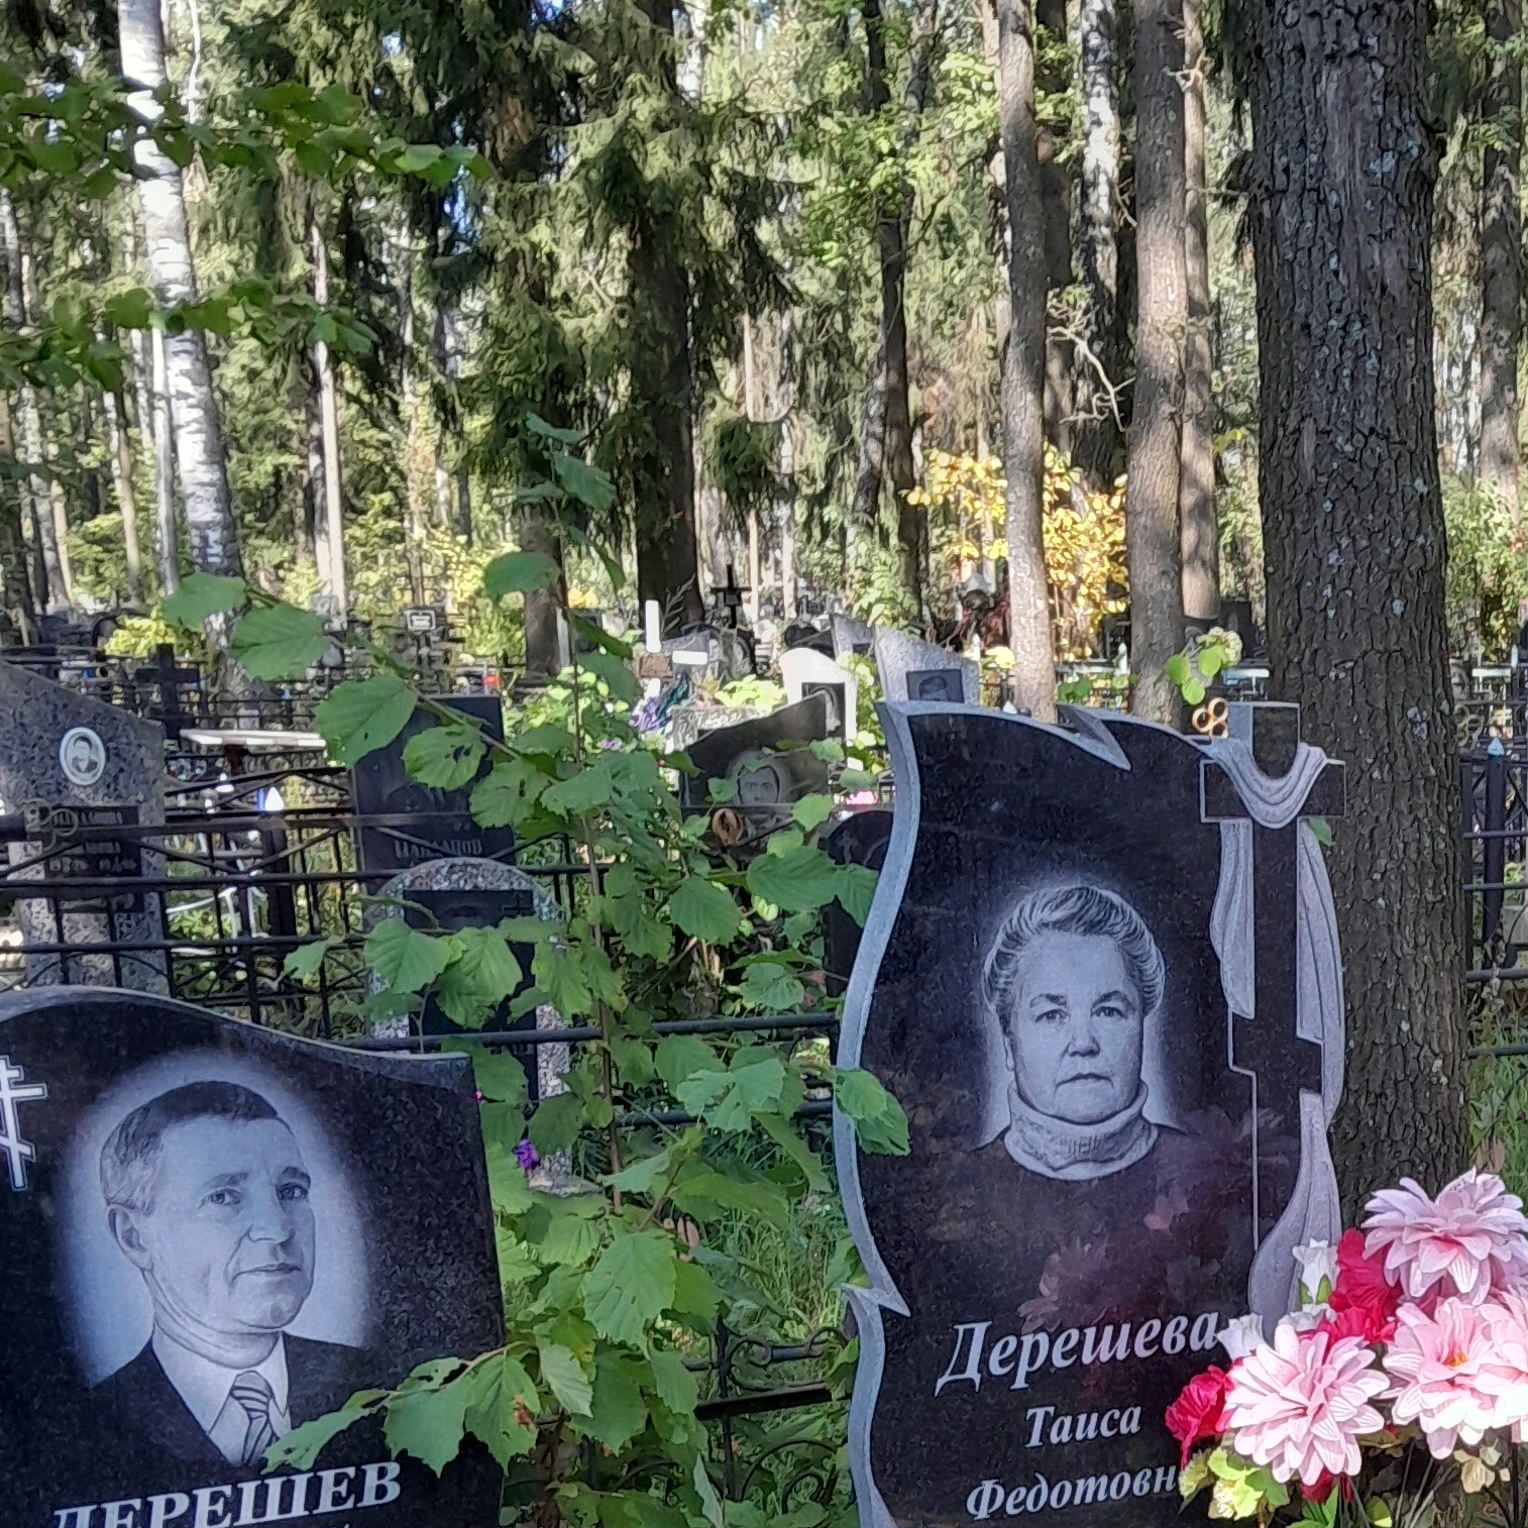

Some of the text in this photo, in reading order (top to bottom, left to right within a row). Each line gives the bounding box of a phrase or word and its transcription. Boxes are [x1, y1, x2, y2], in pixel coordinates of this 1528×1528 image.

[934, 1311, 1219, 1396] Дерешева
[1025, 1405, 1141, 1448] Таиса
[966, 1464, 1176, 1521] Федотовн
